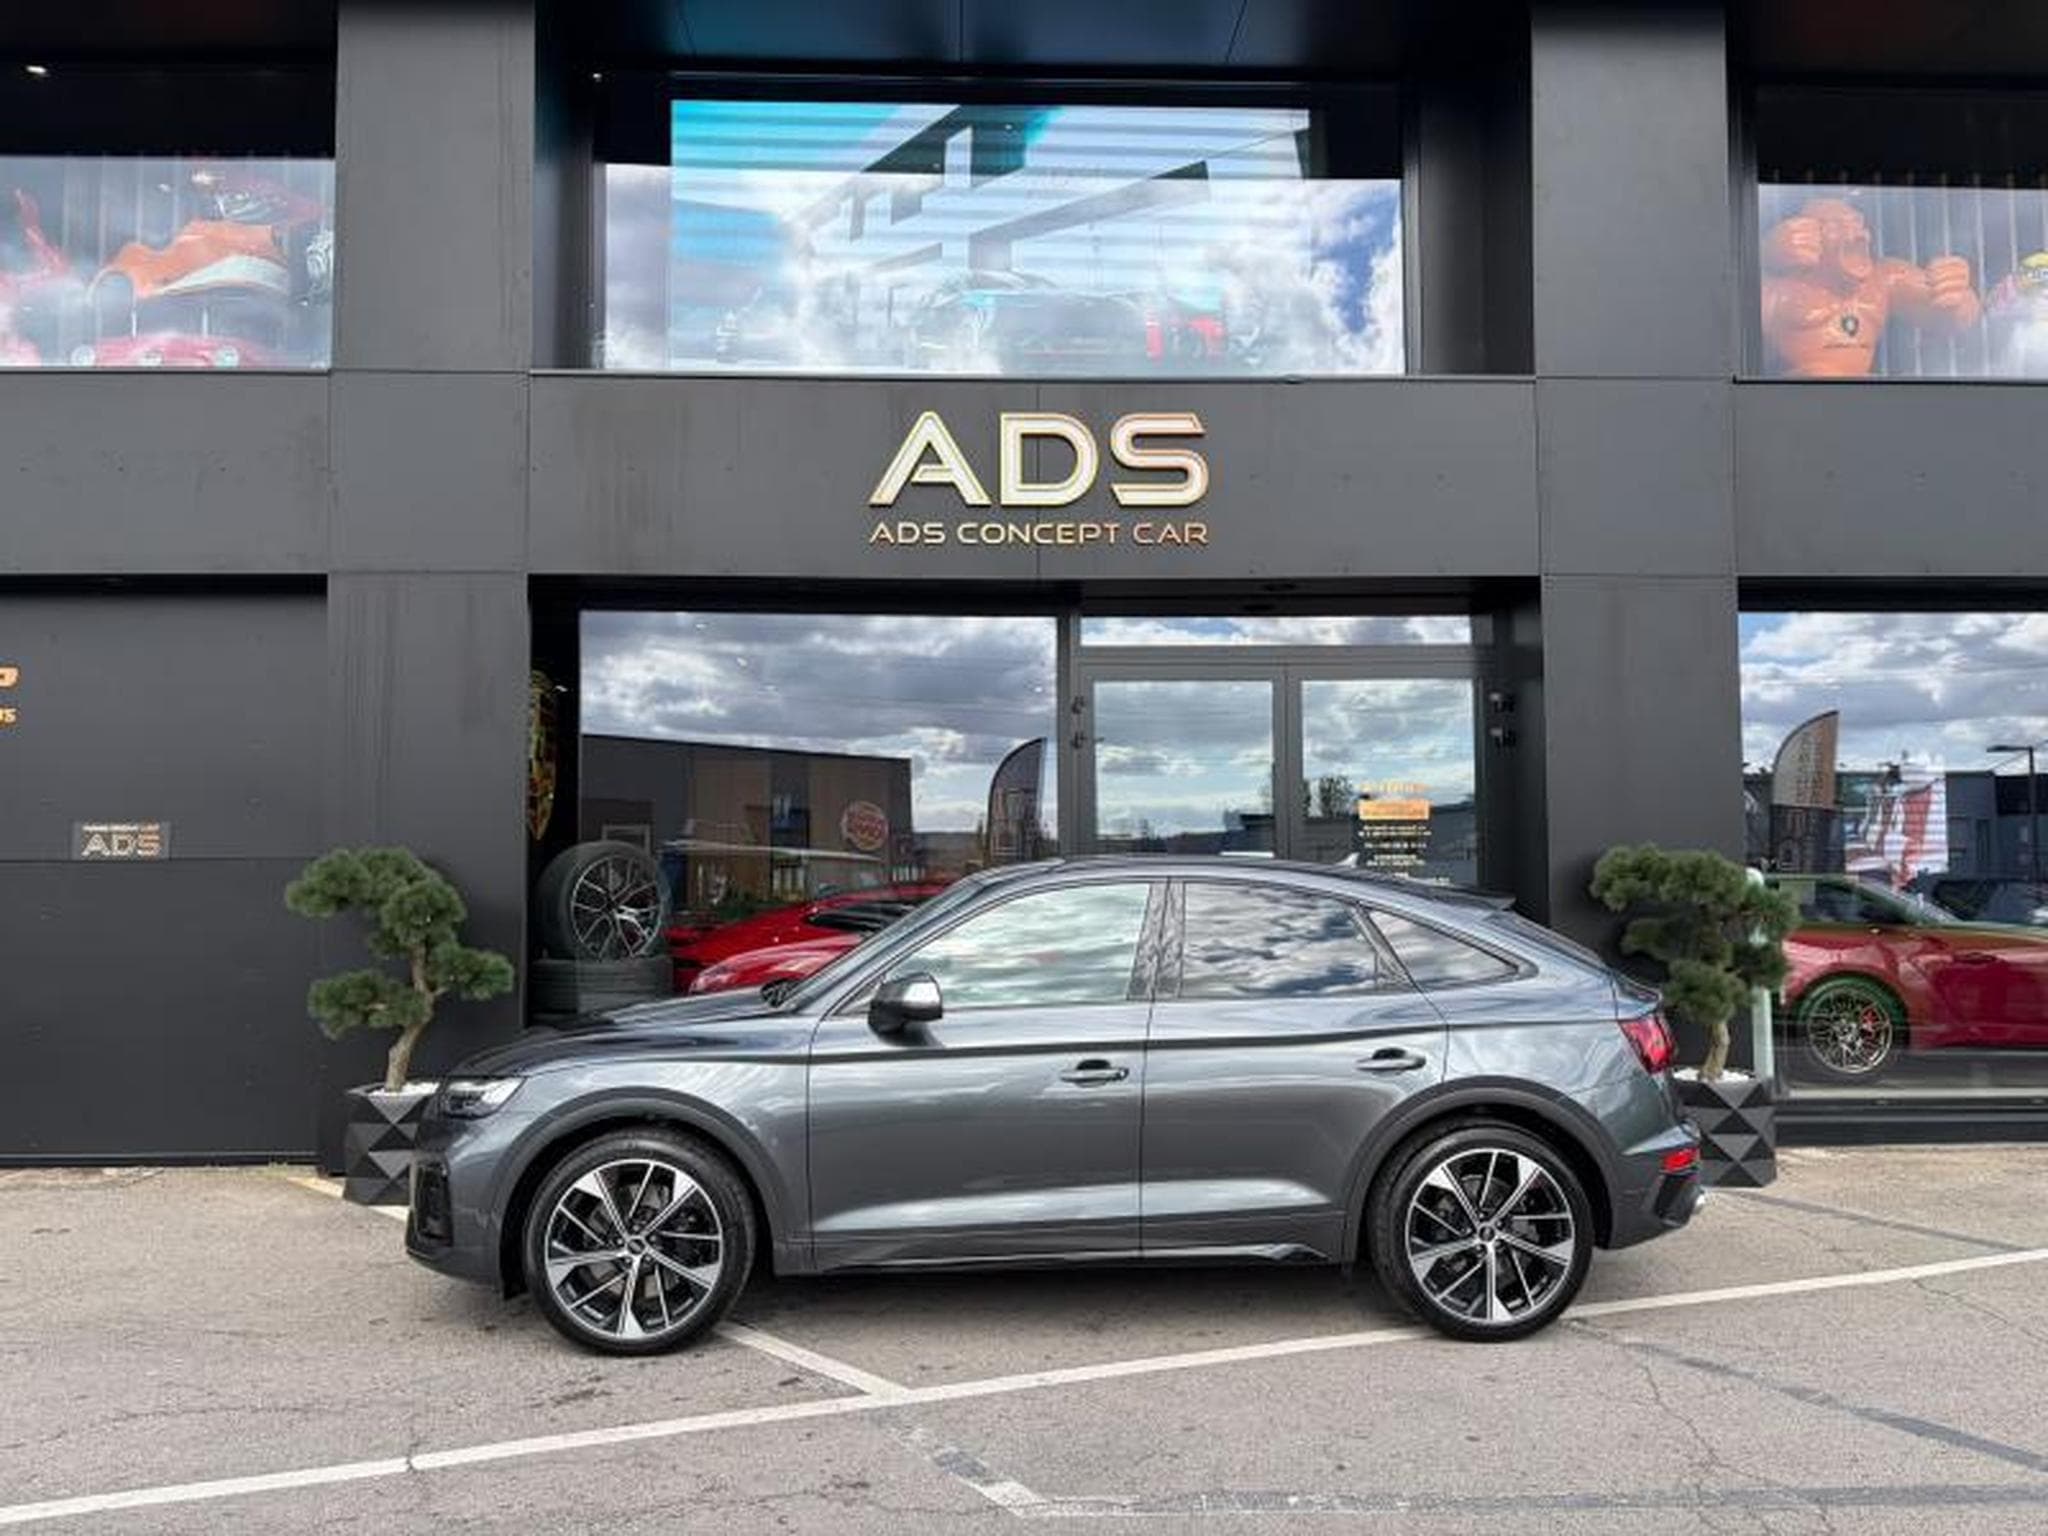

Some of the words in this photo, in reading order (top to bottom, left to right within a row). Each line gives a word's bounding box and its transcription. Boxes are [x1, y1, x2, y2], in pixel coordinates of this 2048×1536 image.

[869, 411, 1210, 507] ADS
[869, 522, 946, 545] ADS
[956, 522, 1120, 545] CONCEPT
[1132, 522, 1210, 545] CAR
[81, 833, 161, 856] ADS
